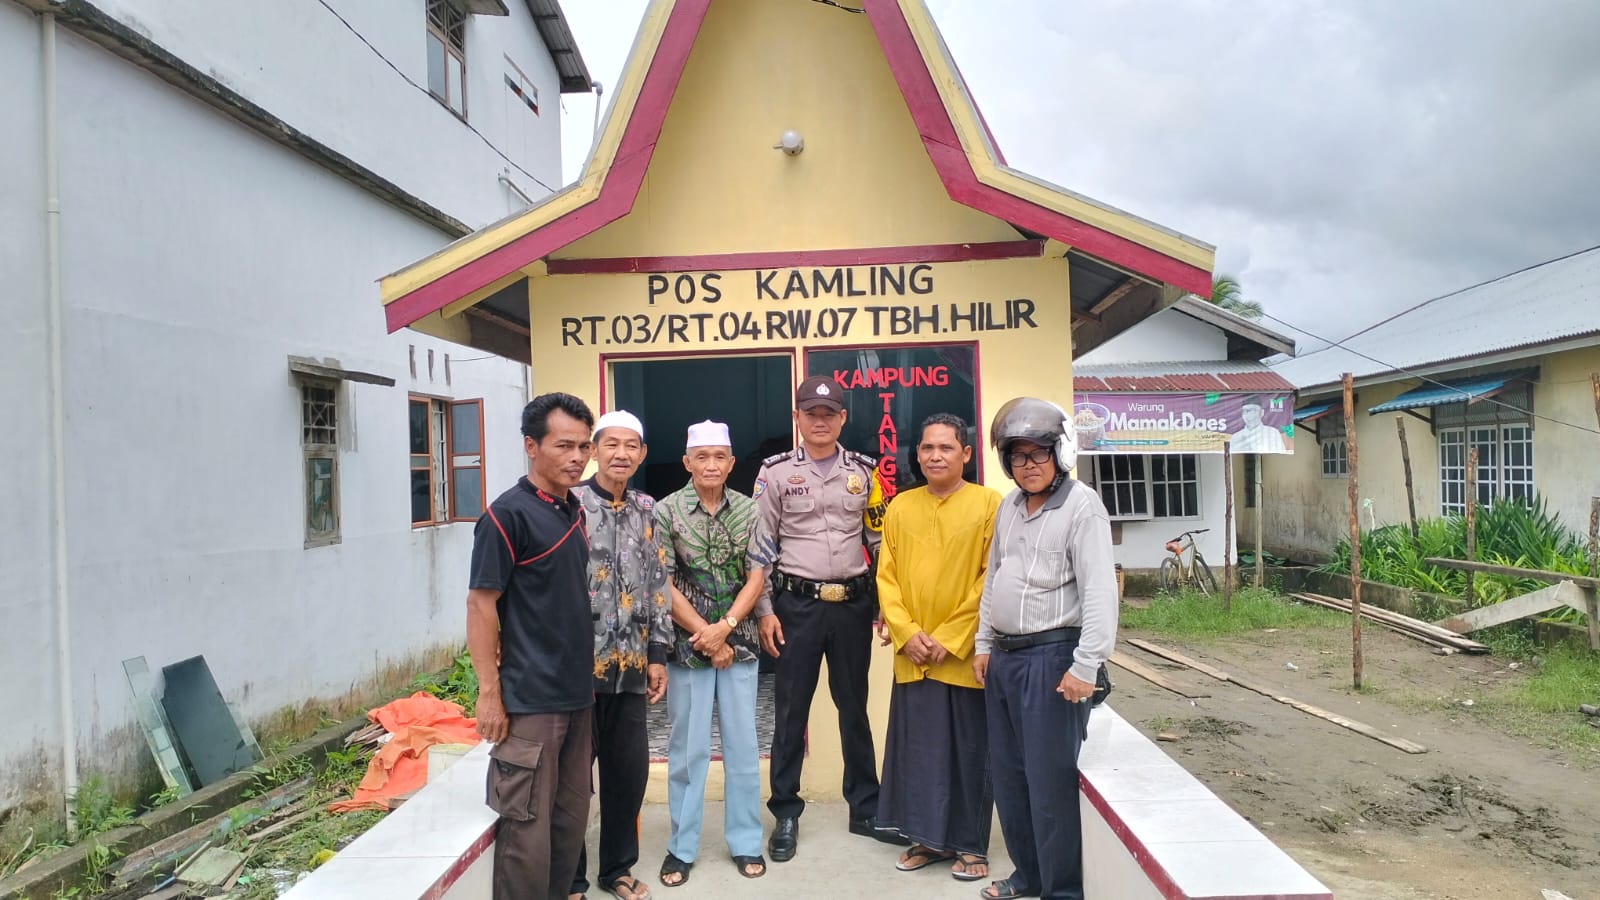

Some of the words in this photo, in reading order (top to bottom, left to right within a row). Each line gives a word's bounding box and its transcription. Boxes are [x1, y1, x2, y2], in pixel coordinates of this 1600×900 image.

[648, 273, 721, 304] POS
[756, 265, 933, 300] KAMLING
[561, 311, 762, 346] RT.03/RT.04
[766, 307, 857, 340] RW.07
[864, 299, 1038, 336] TBH.HILIR
[833, 366, 949, 390] KAMPUNG
[1127, 402, 1165, 413] Warung
[1110, 411, 1227, 432] MamakDaes
[784, 486, 810, 497] ANDY
